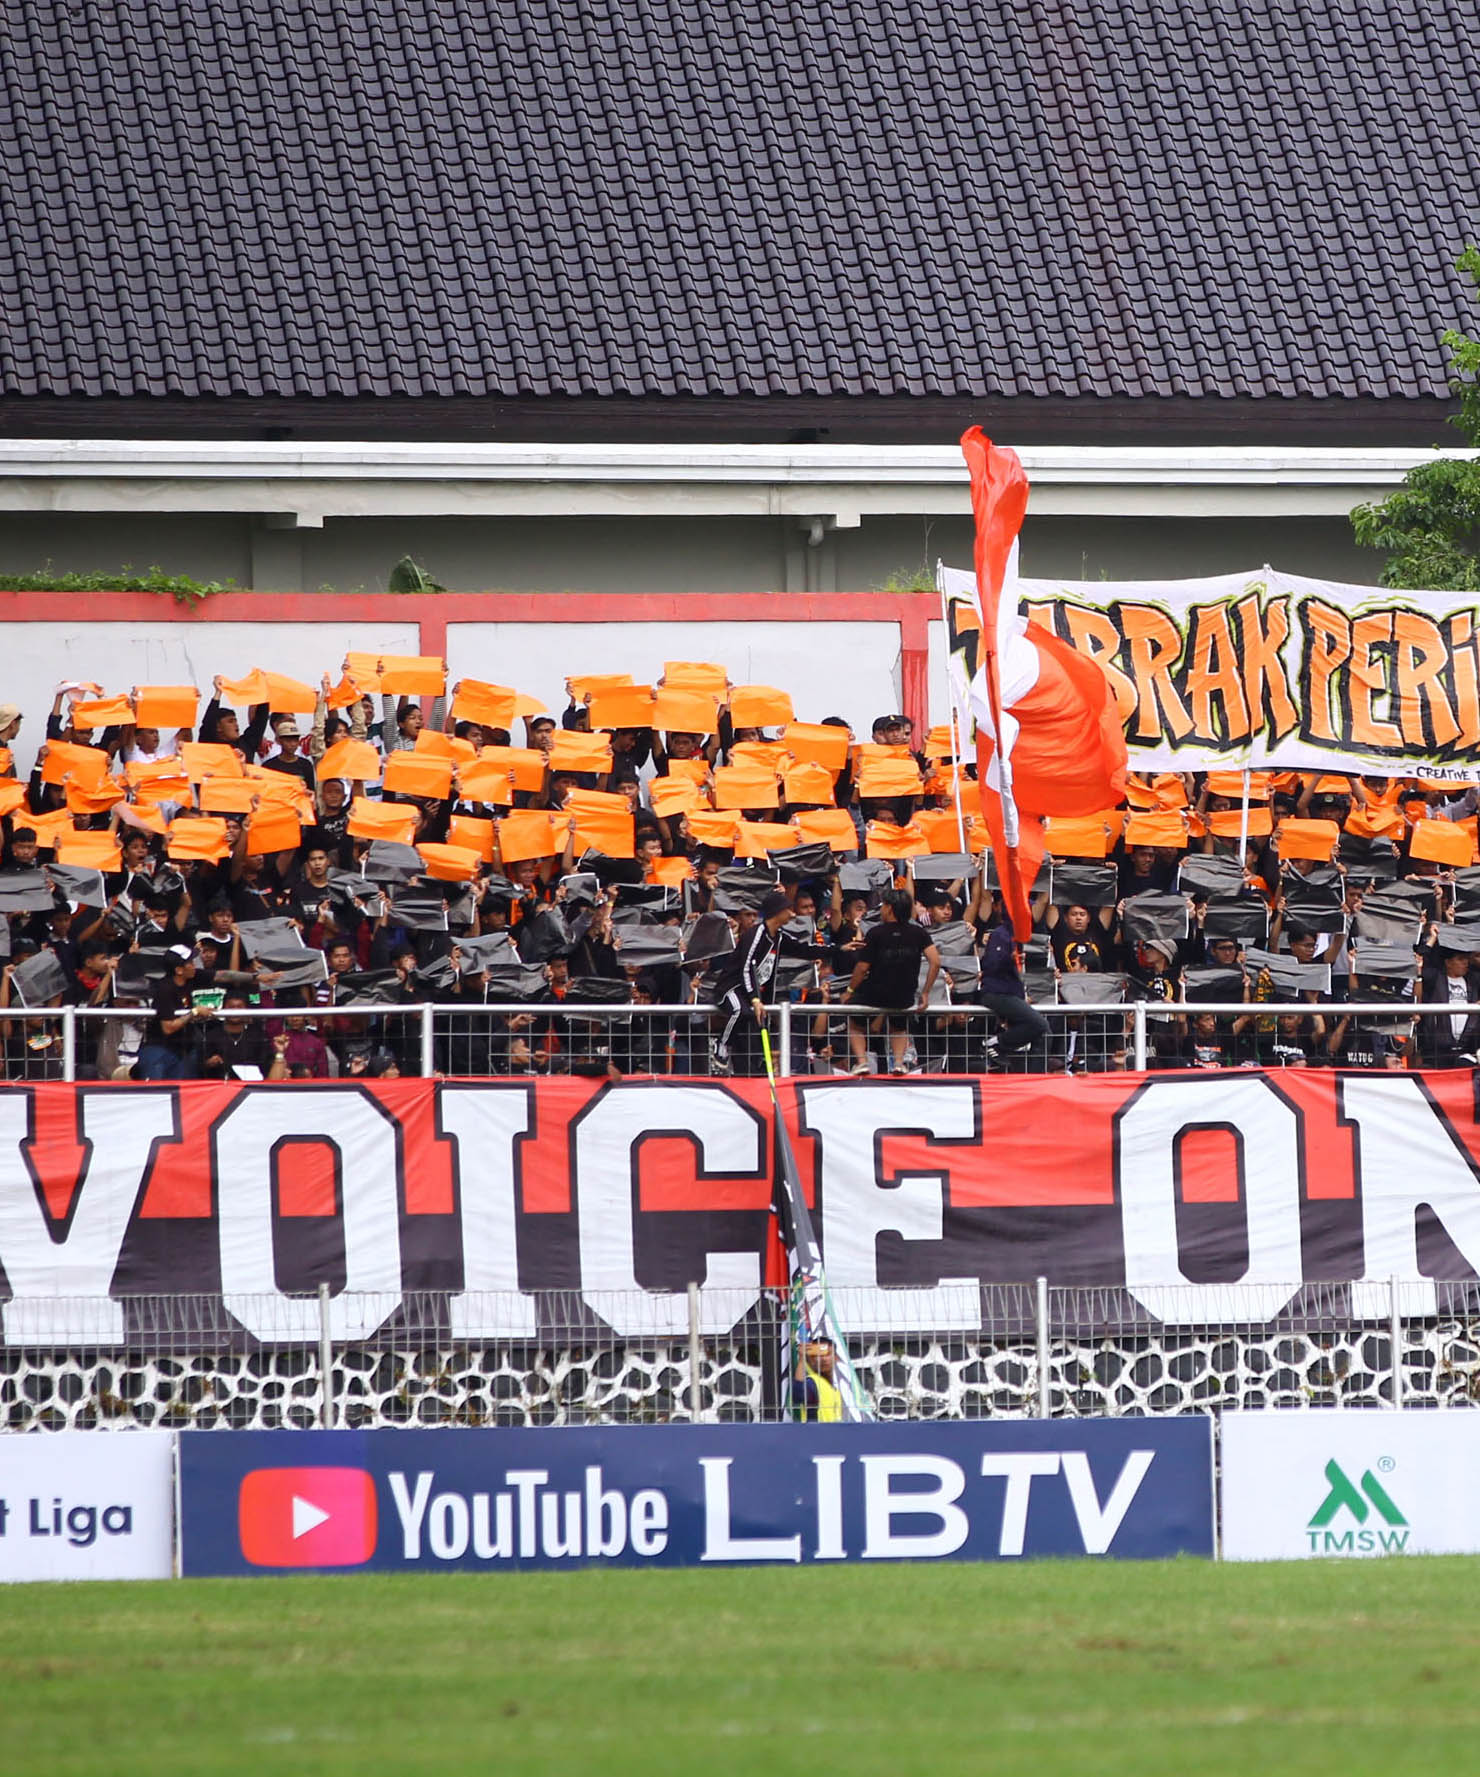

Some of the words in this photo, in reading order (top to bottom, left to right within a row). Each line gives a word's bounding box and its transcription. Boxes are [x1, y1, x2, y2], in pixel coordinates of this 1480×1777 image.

[0, 1081, 983, 1346] VOICE
[29, 1498, 132, 1548] Liga
[388, 1466, 669, 1560] YouTube
[1306, 1530, 1410, 1552] TMSW
